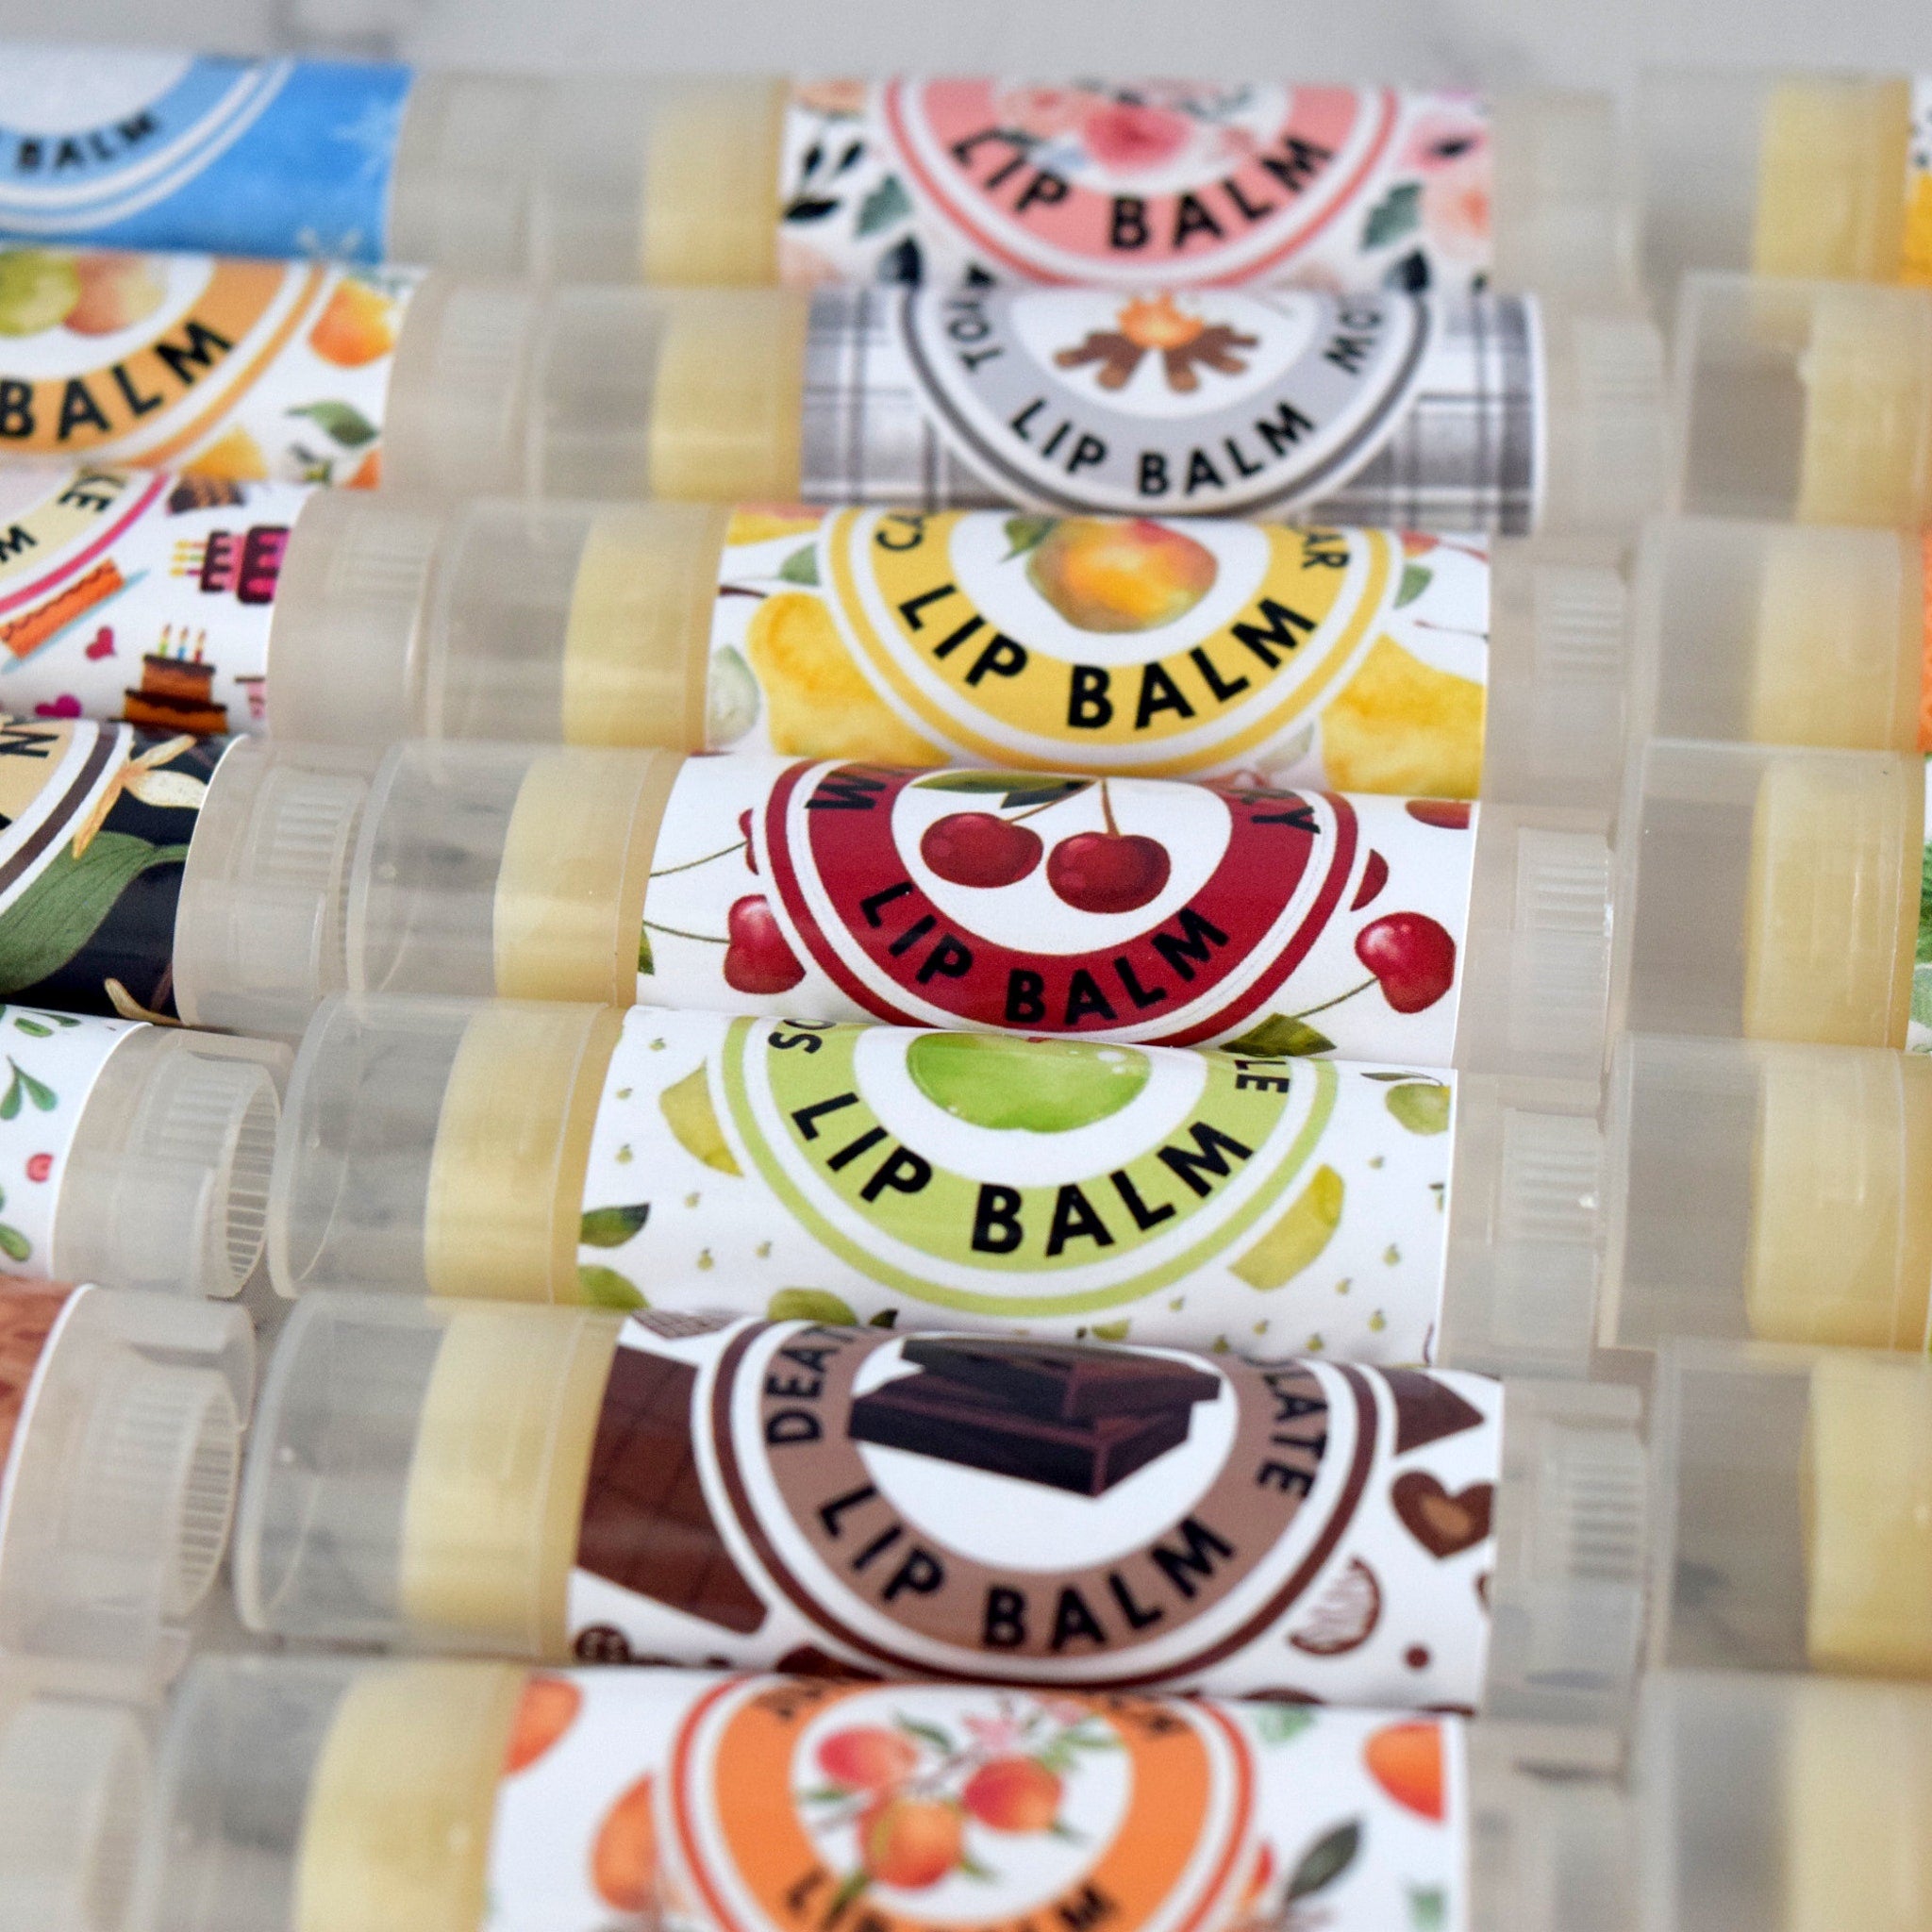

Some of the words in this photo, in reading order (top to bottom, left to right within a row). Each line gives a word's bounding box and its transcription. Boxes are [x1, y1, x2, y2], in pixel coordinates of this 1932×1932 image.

[17, 110, 157, 172] BALM
[950, 128, 1071, 214] LIP
[1109, 136, 1328, 251] BALM
[0, 321, 234, 441] BALM
[1010, 397, 1108, 475] LIP
[1138, 400, 1317, 496] BALM
[899, 583, 1028, 687] LIP
[1067, 598, 1316, 730] BALM
[859, 881, 974, 984] LIP
[1004, 908, 1230, 1026] BALM
[791, 1091, 932, 1203] LIP
[971, 1121, 1254, 1257] BALM
[818, 1485, 945, 1604] LIP
[980, 1515, 1234, 1652] BALM
